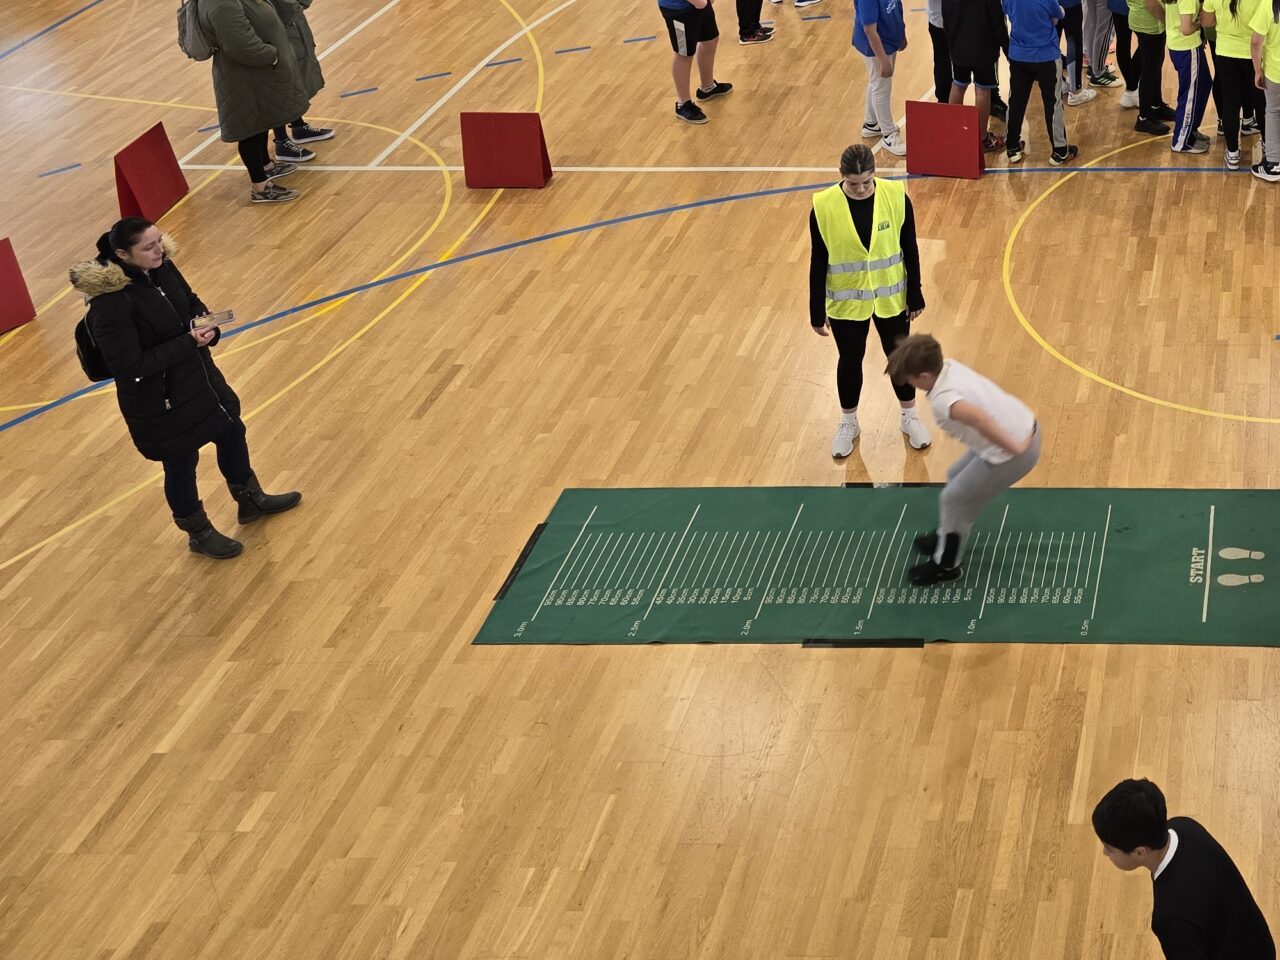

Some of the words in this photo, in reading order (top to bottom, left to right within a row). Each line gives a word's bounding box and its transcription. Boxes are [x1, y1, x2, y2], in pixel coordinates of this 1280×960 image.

[1189, 547, 1206, 583] START
[513, 621, 528, 638] 3.0m
[628, 620, 640, 637] 2.5m
[740, 619, 752, 636] 2.0m
[854, 619, 864, 635] 1.5m
[967, 619, 977, 635] 1.0m
[1080, 619, 1089, 636] 0.5m
